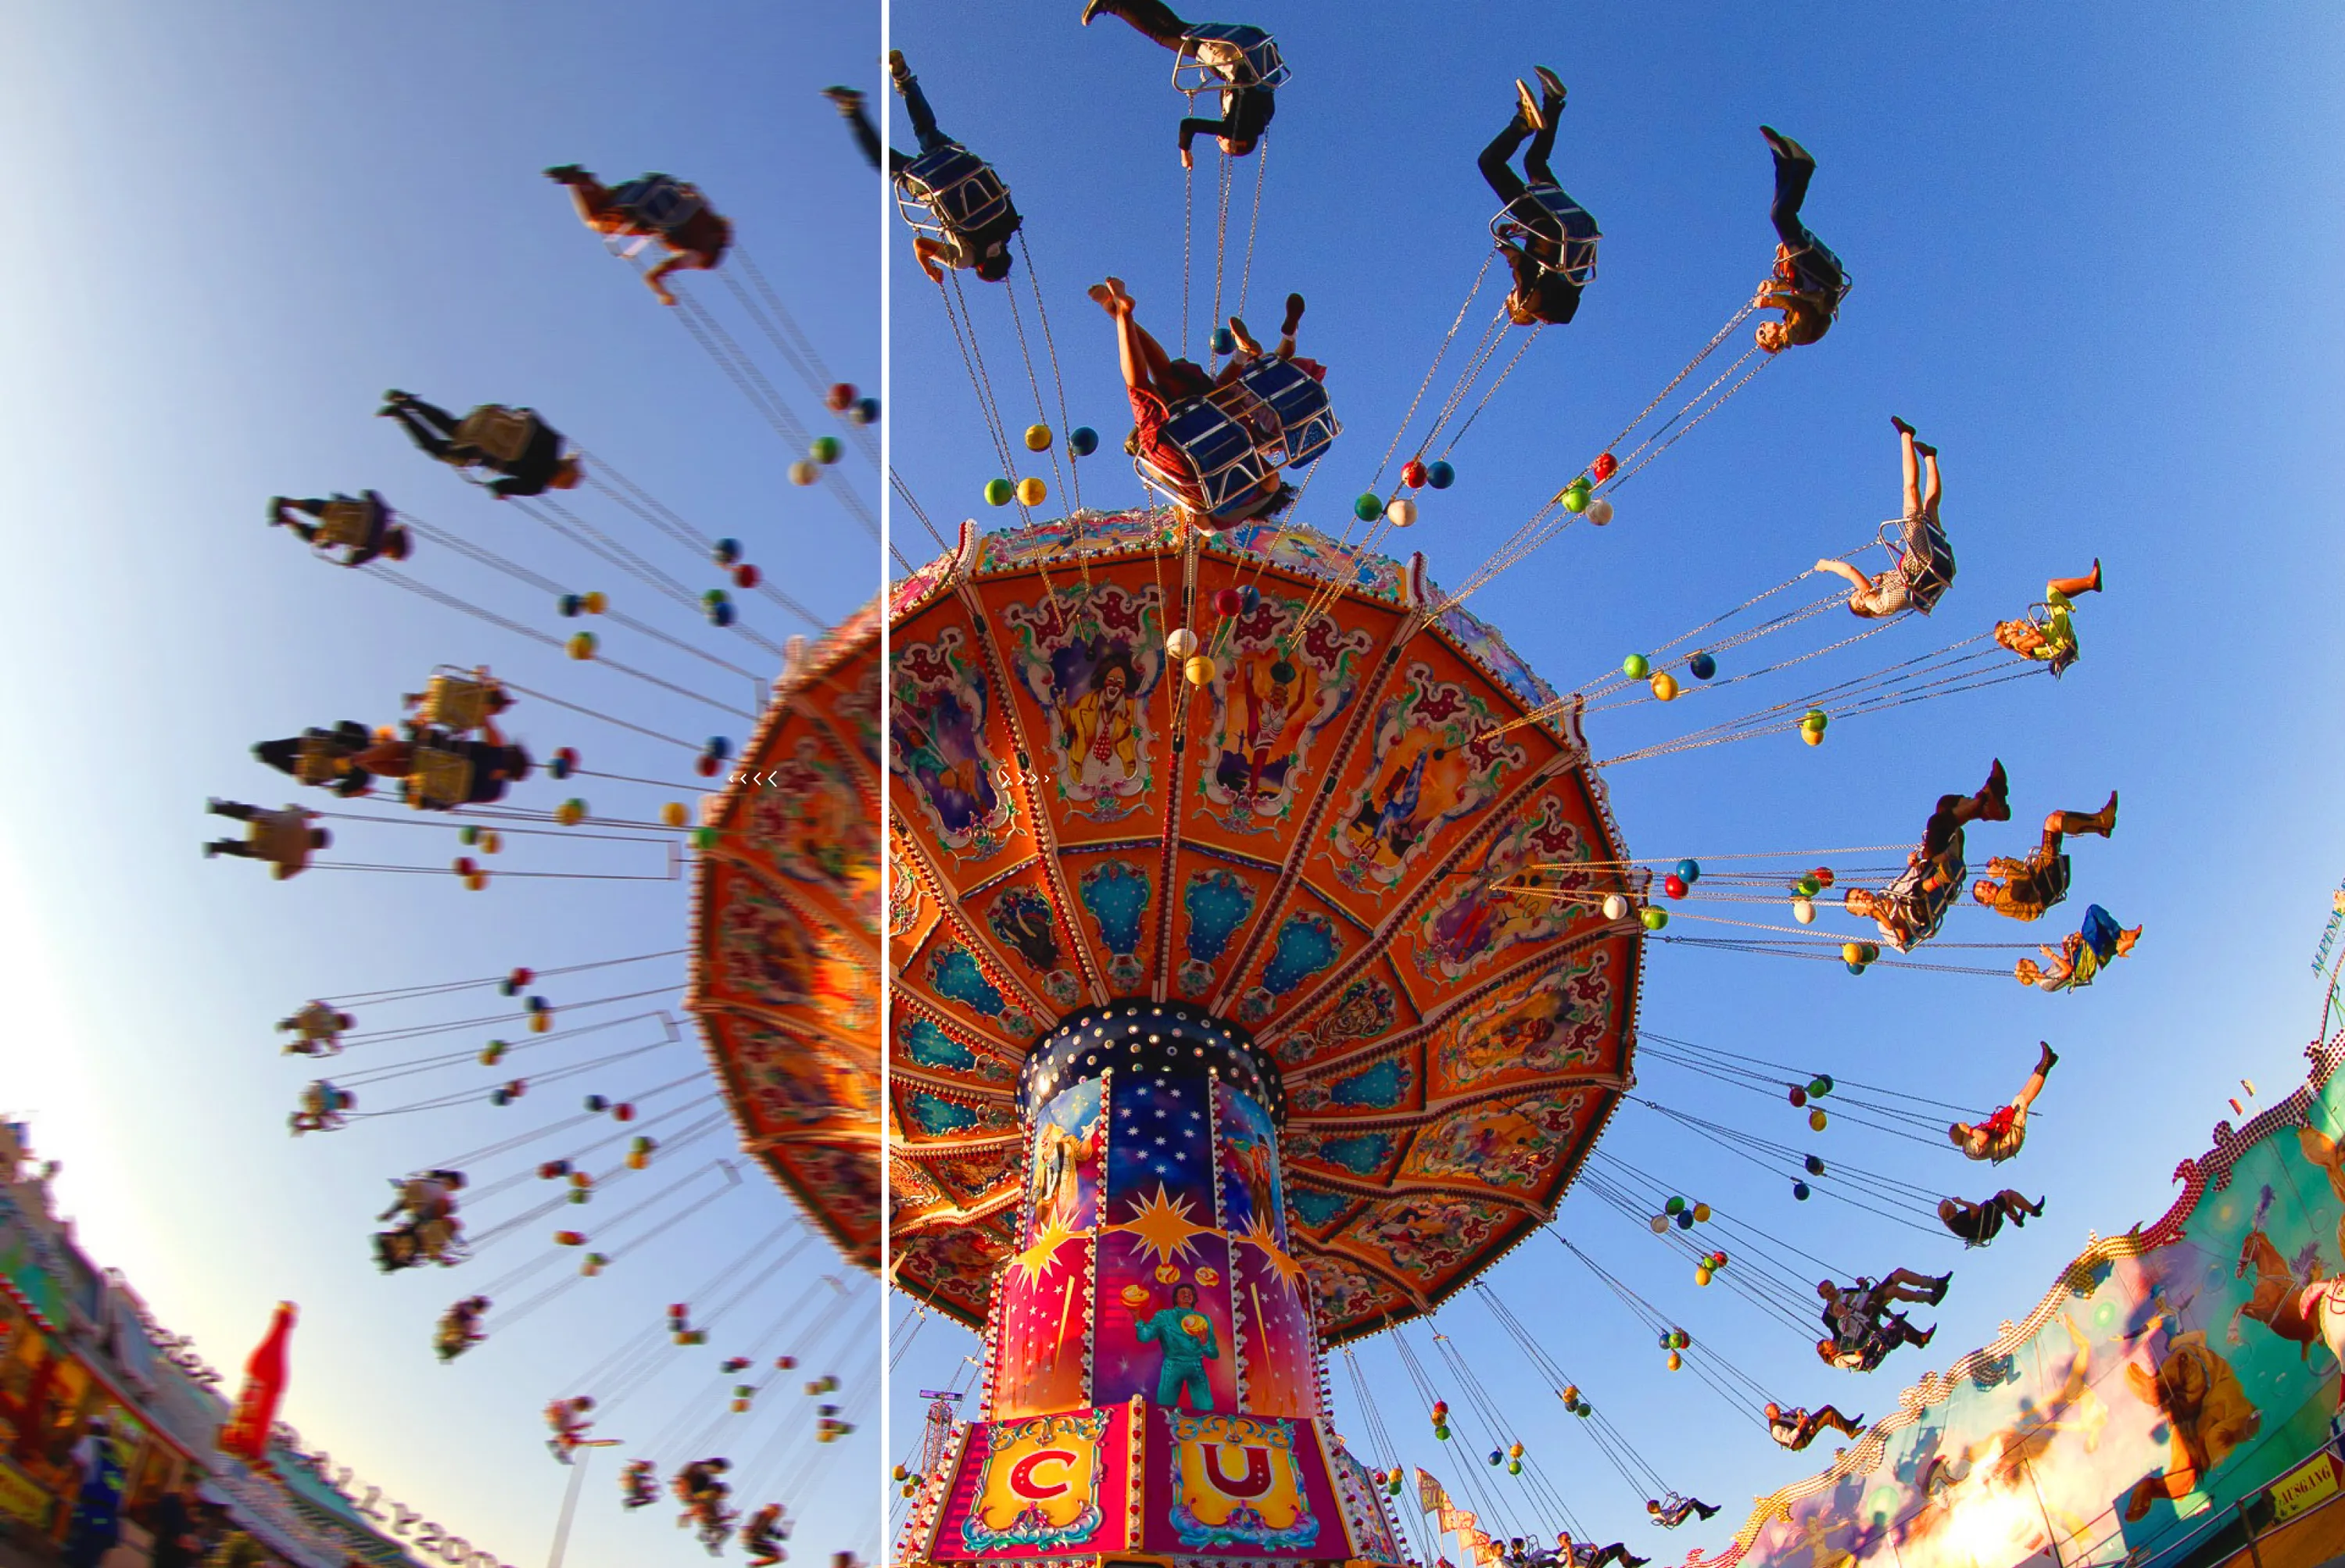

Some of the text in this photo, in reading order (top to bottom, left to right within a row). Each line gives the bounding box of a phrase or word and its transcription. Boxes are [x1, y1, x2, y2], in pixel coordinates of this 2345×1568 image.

[1009, 1448, 1078, 1501] C
[1198, 1442, 1273, 1499] U
[2281, 1465, 2331, 1504] AUSGANG
